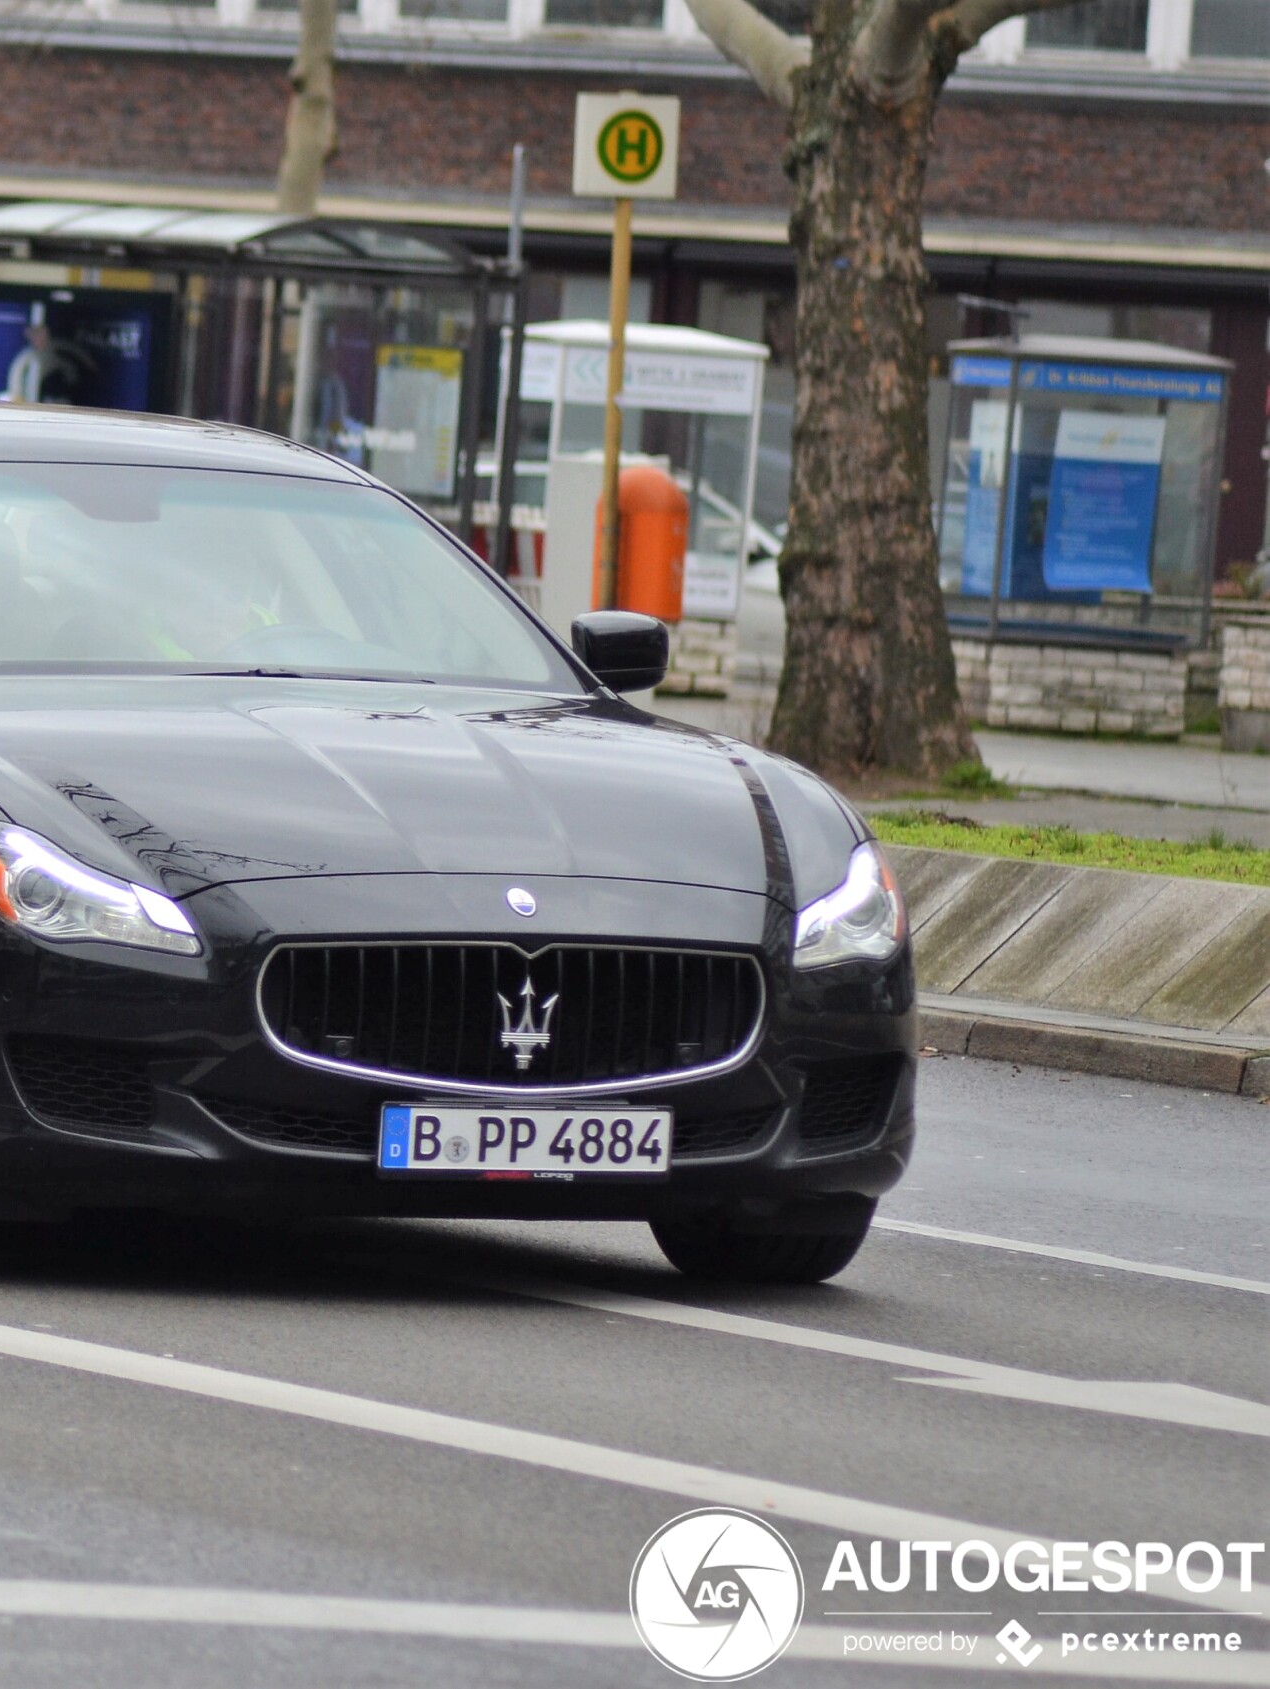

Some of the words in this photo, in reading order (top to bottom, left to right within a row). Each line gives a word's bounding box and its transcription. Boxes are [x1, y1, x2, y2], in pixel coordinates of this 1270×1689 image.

[617, 127, 647, 166] H
[390, 1144, 401, 1157] D
[412, 1115, 442, 1162] B
[478, 1116, 537, 1163] PP
[548, 1118, 663, 1165] 4884
